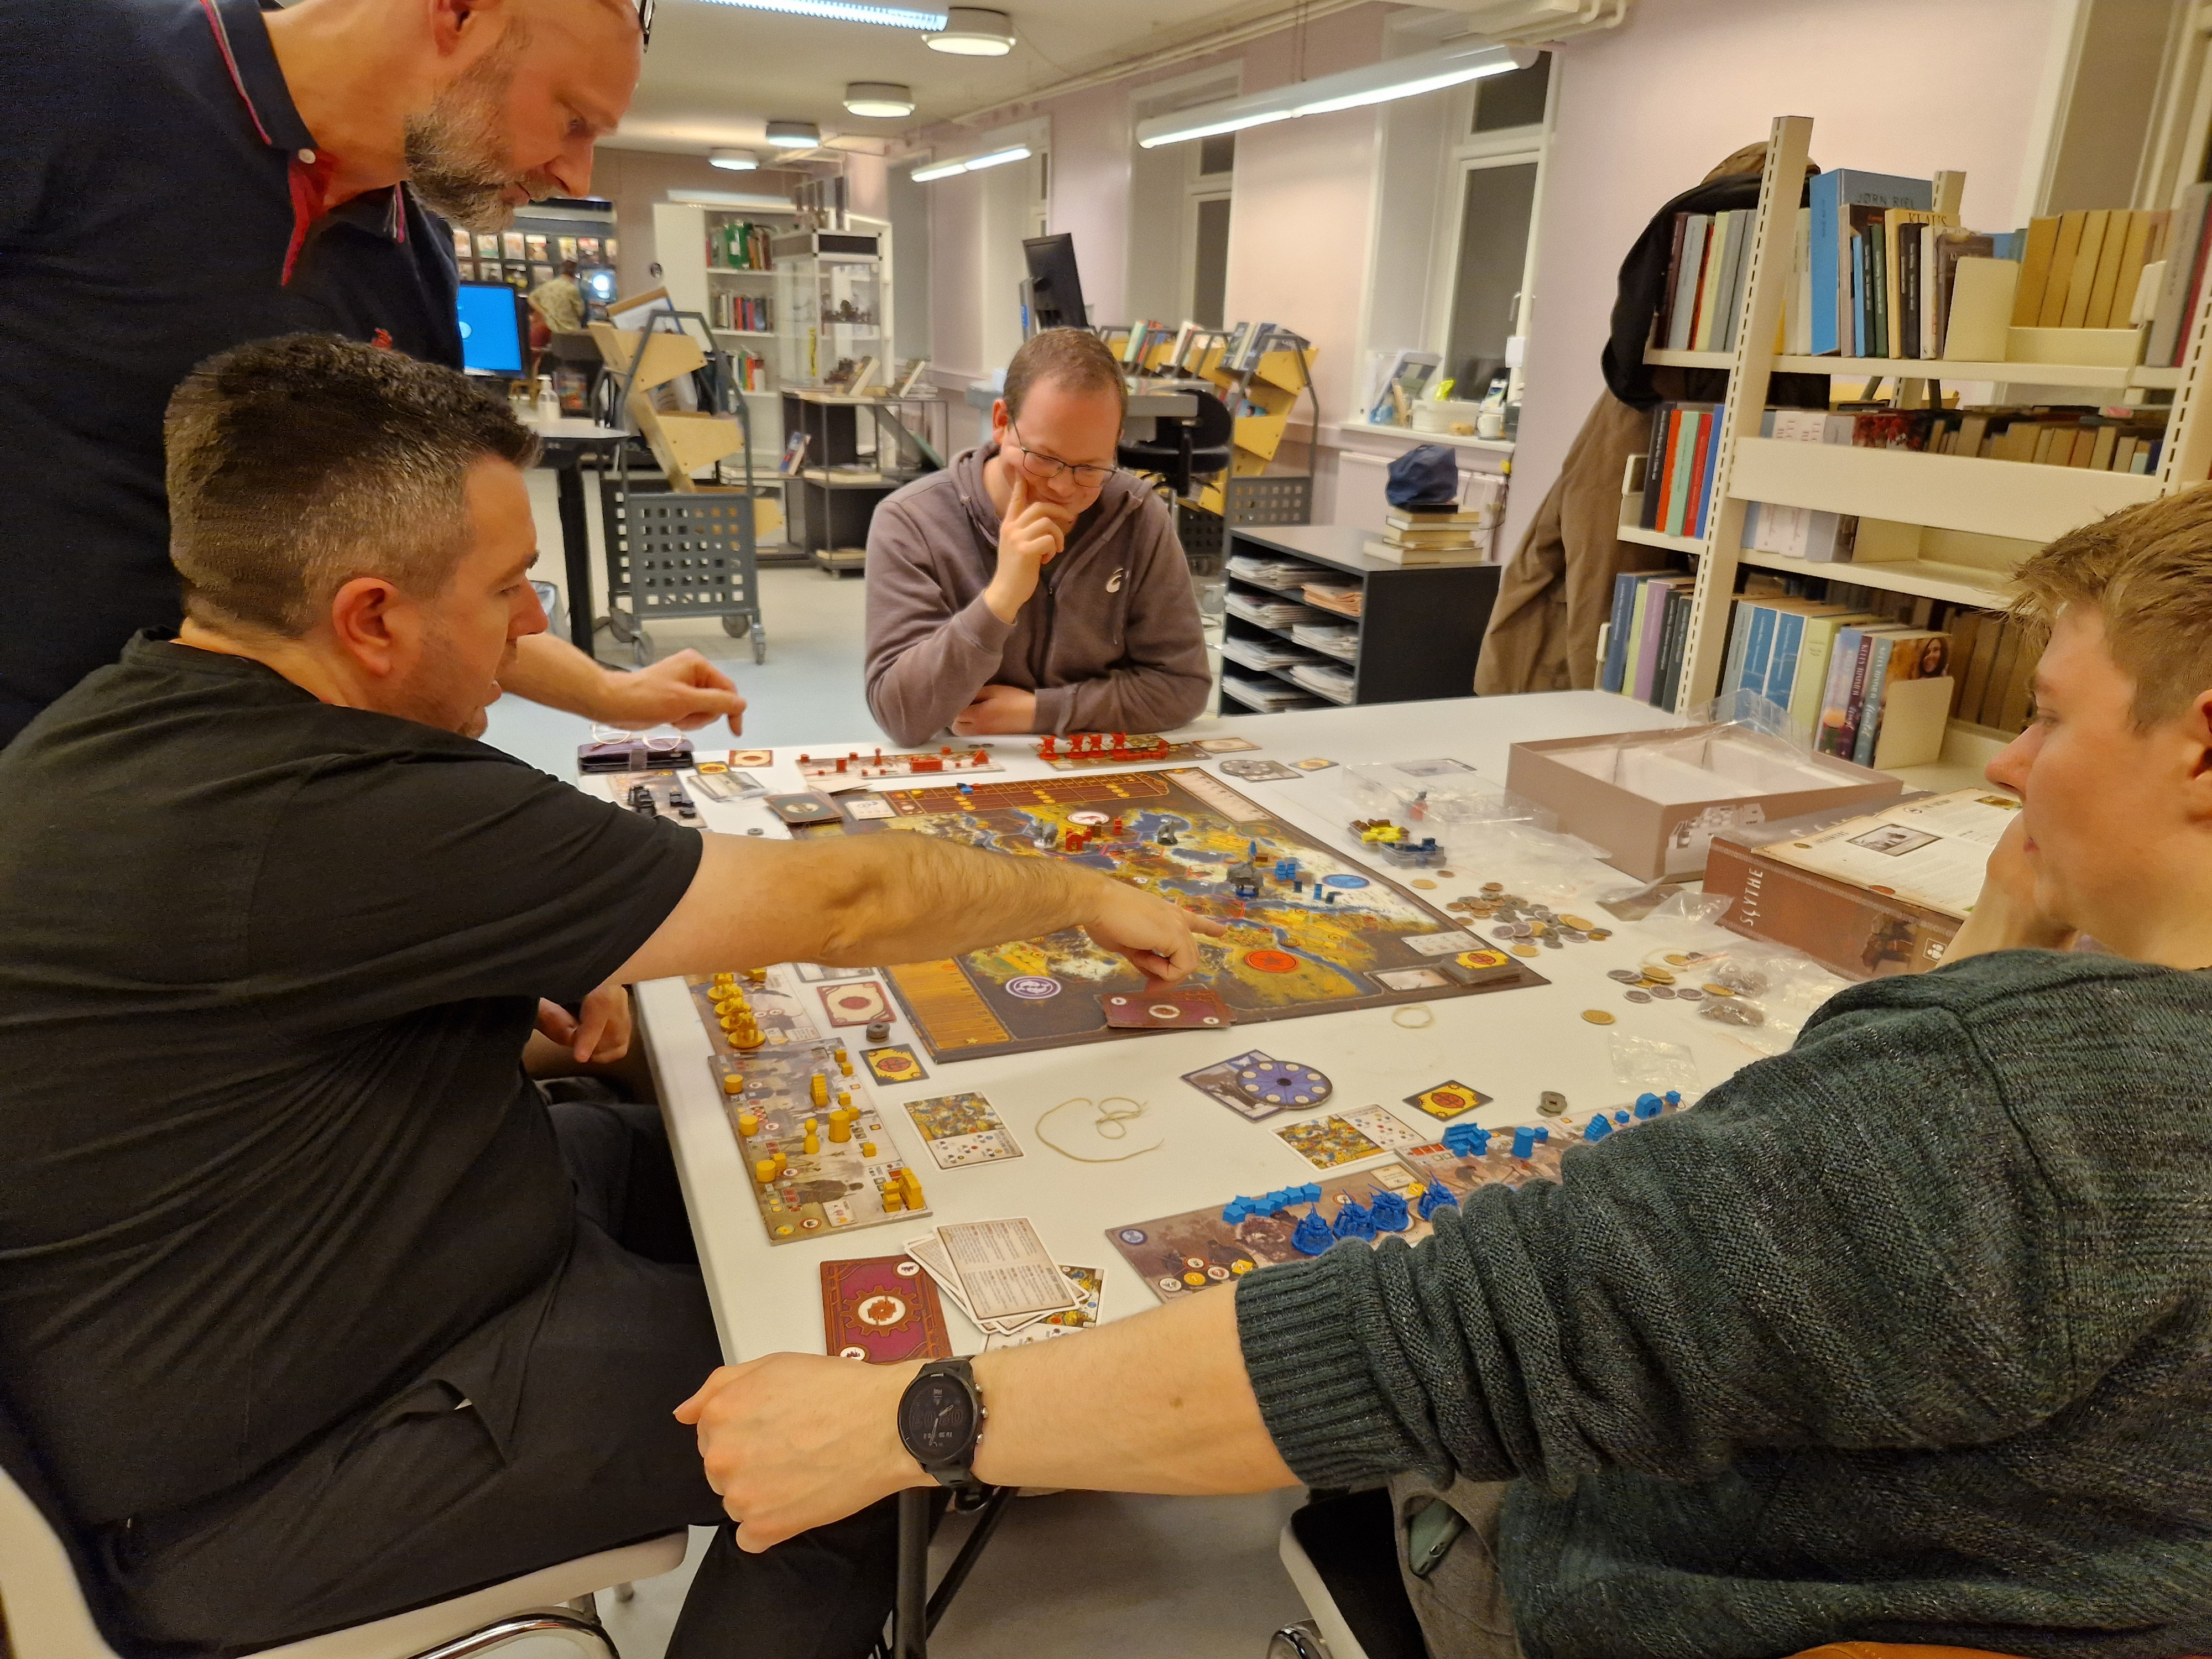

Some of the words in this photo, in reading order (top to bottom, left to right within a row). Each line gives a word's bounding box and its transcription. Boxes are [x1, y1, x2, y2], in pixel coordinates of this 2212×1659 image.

[1857, 193, 1887, 207] JØRN
[1908, 212, 1947, 226] KLAUS
[1858, 644, 1869, 665] KELLY
[1851, 667, 1864, 696] RIMMER
[1739, 867, 1764, 927] SCYTHE
